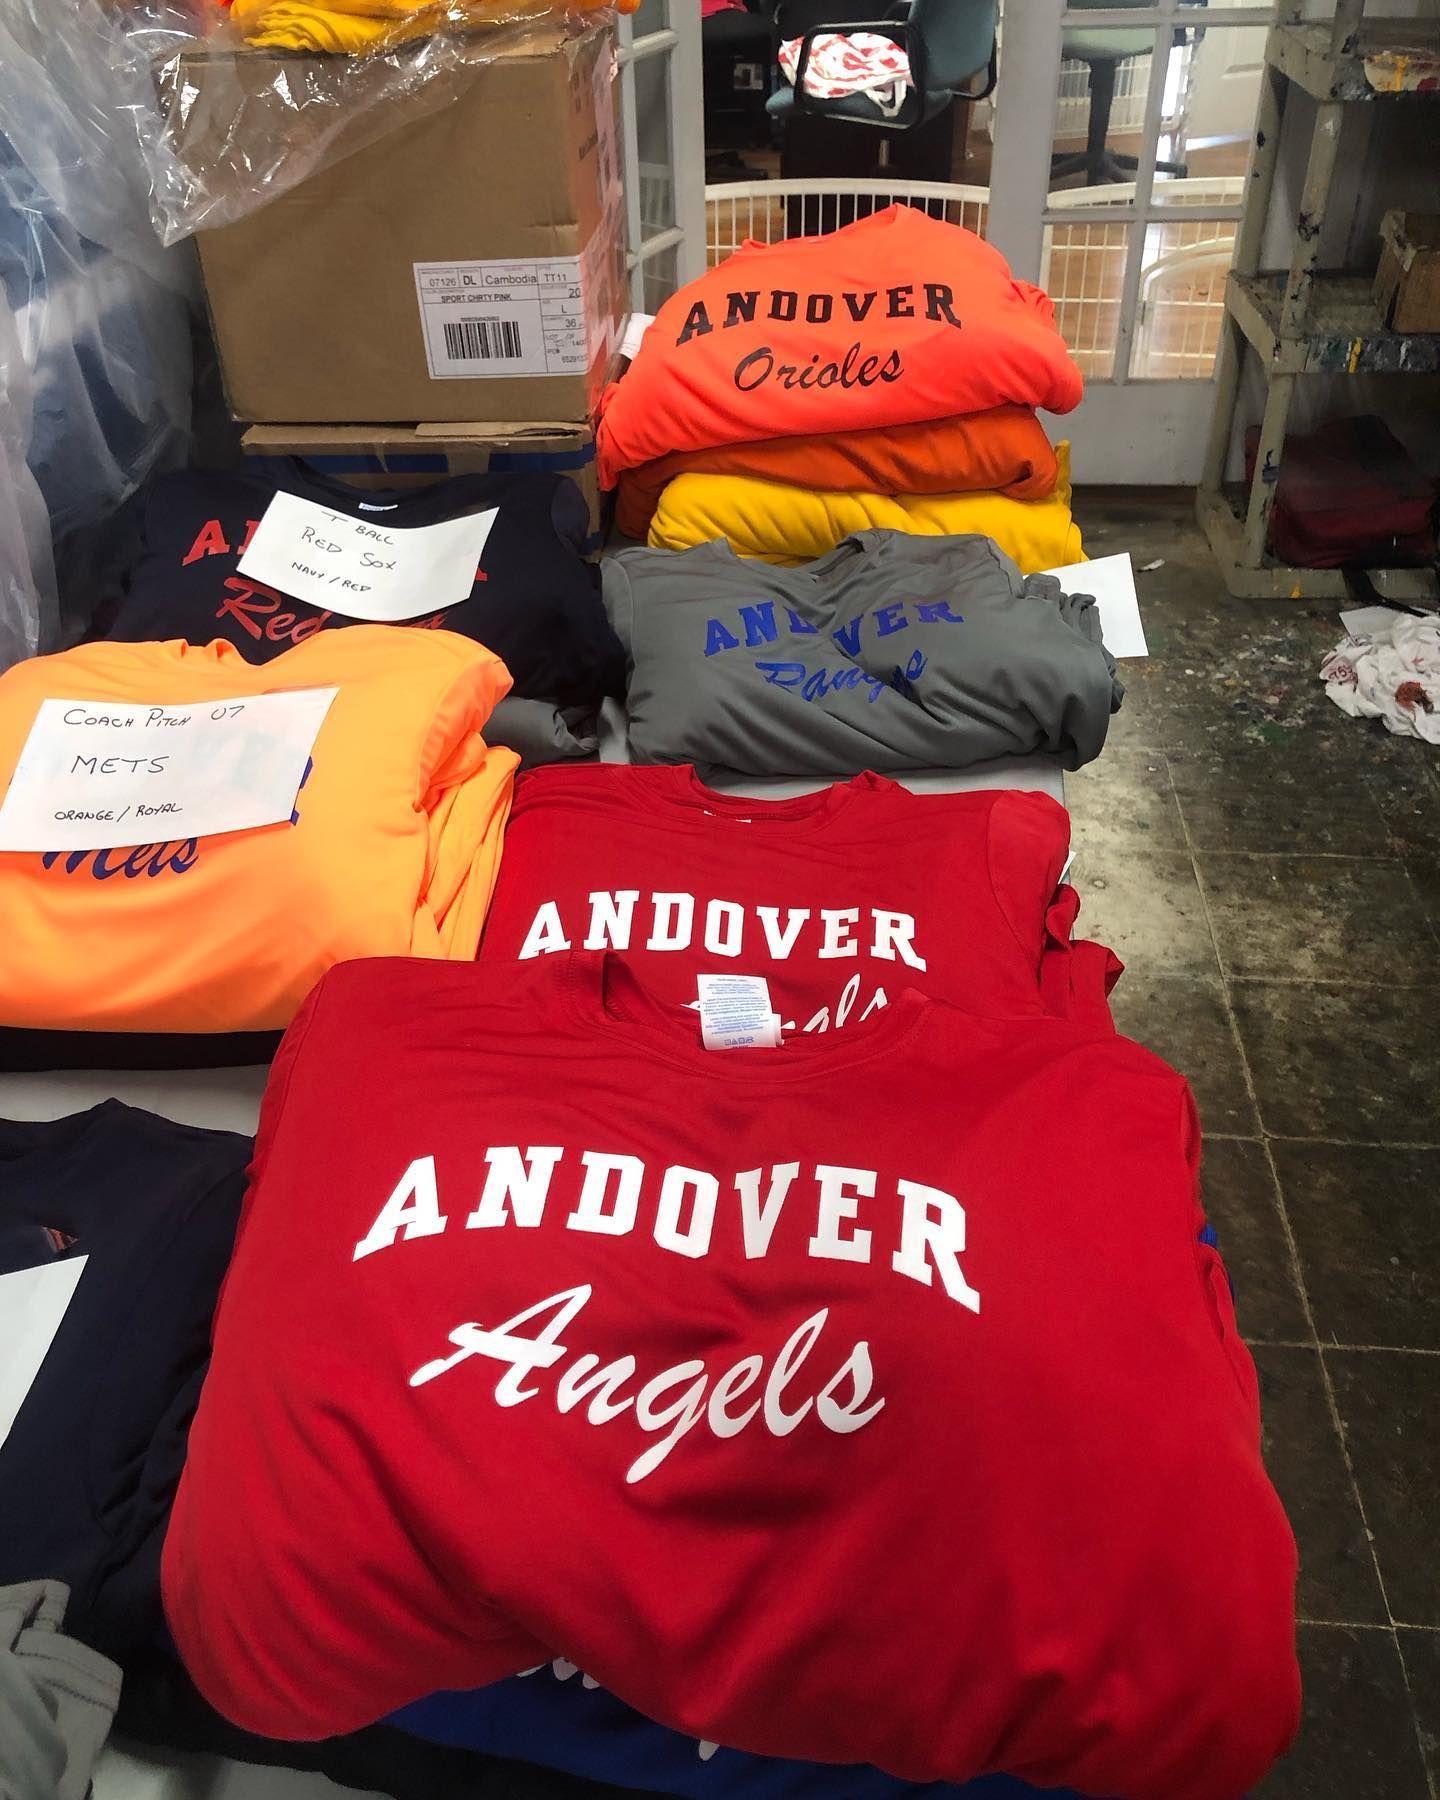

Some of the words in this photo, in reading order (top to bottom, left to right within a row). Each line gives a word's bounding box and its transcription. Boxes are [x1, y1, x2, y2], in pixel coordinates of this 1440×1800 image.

[463, 275, 477, 286] DL
[485, 275, 538, 285] Cambodia
[544, 273, 567, 282] TT11
[441, 294, 465, 304] SPORT
[494, 293, 512, 302] PINK
[561, 304, 568, 313] L
[565, 318, 577, 328] 36
[675, 283, 962, 347] ANDOVER
[734, 341, 905, 391] Orioles
[301, 526, 343, 553] RED
[355, 525, 394, 545] BALL
[215, 576, 333, 644] Red
[704, 601, 965, 657] ANVER
[70, 755, 170, 775] METS
[517, 889, 927, 973] ANDOVER
[352, 1145, 981, 1314] ANDOVER
[409, 1283, 885, 1485] Angels
